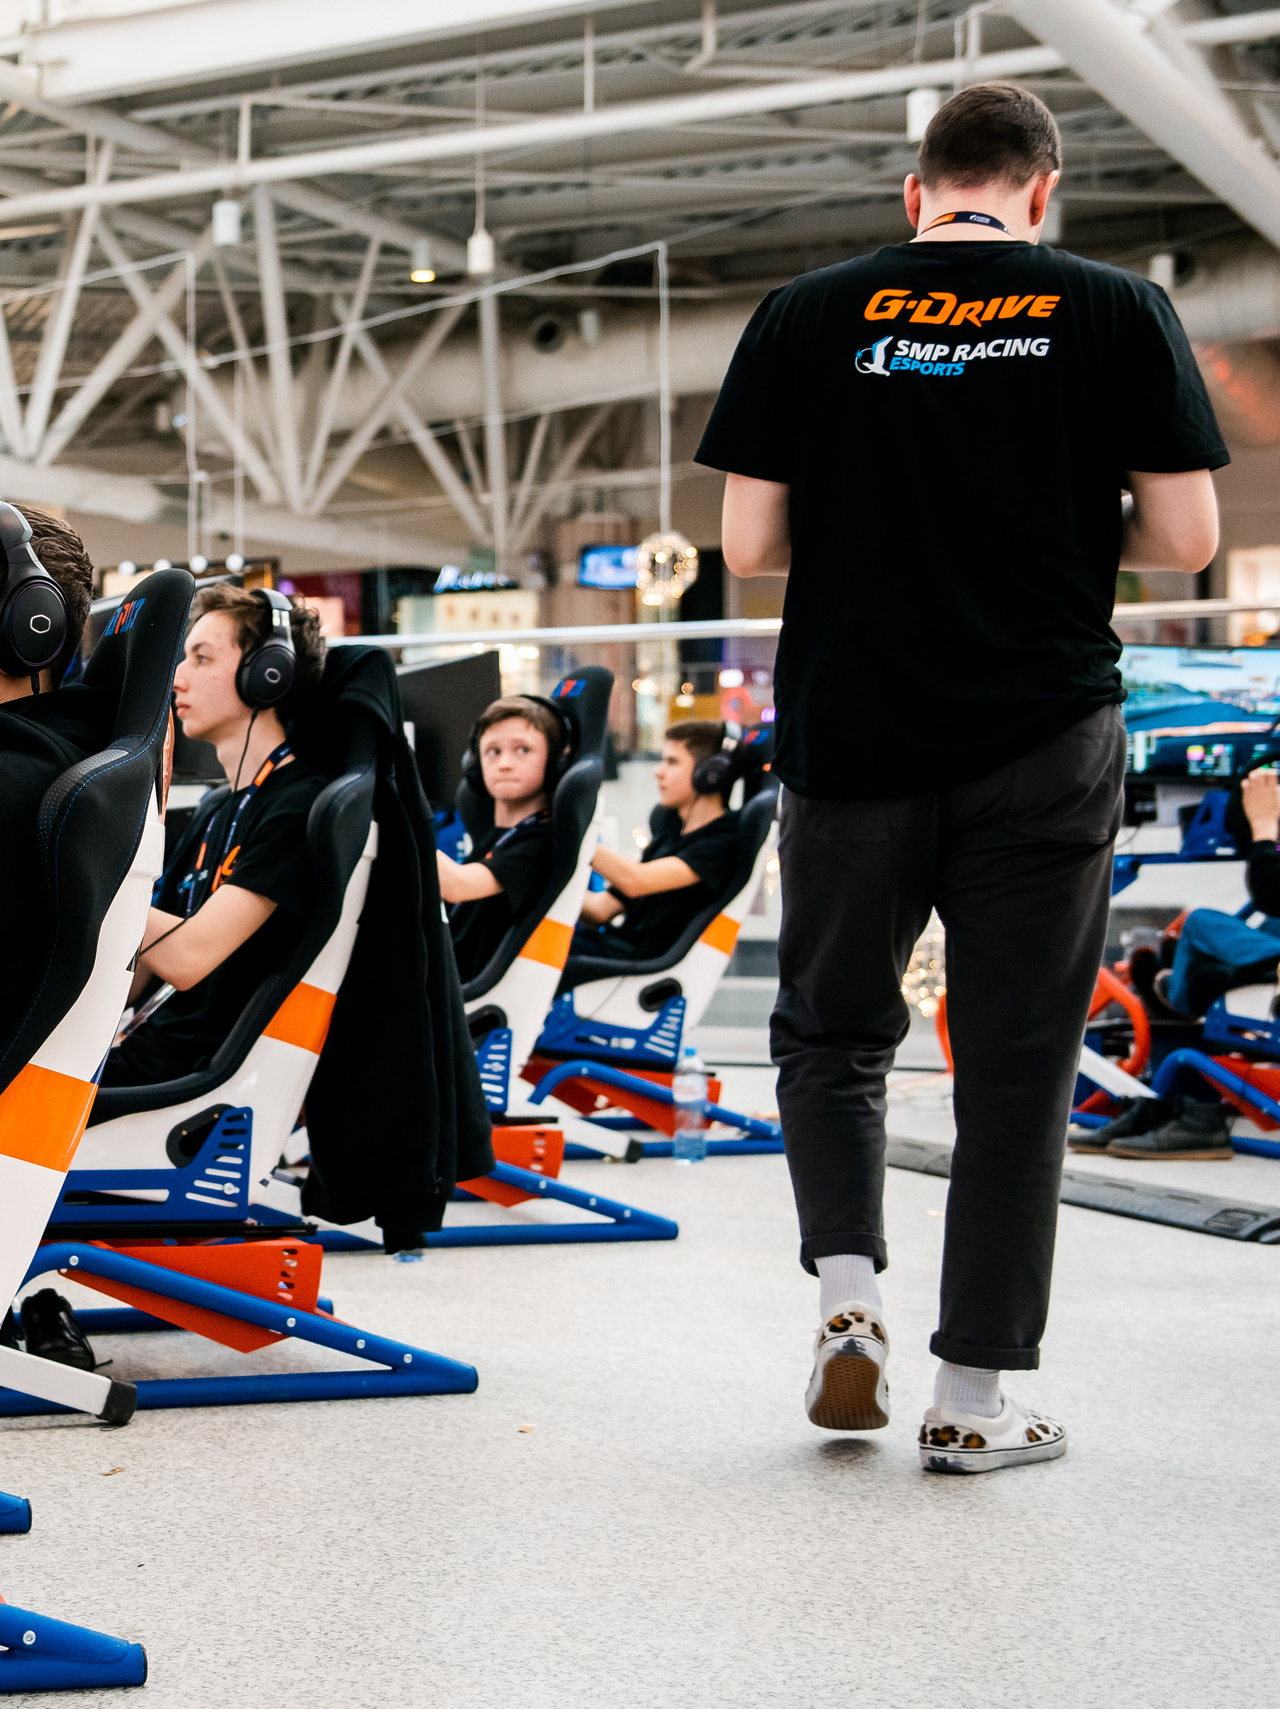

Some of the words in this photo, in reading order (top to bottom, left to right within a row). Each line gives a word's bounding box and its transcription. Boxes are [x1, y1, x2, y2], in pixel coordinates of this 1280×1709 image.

[894, 339, 950, 362] SMP
[952, 337, 1051, 362] RACING
[889, 356, 966, 377] ESPORTS
